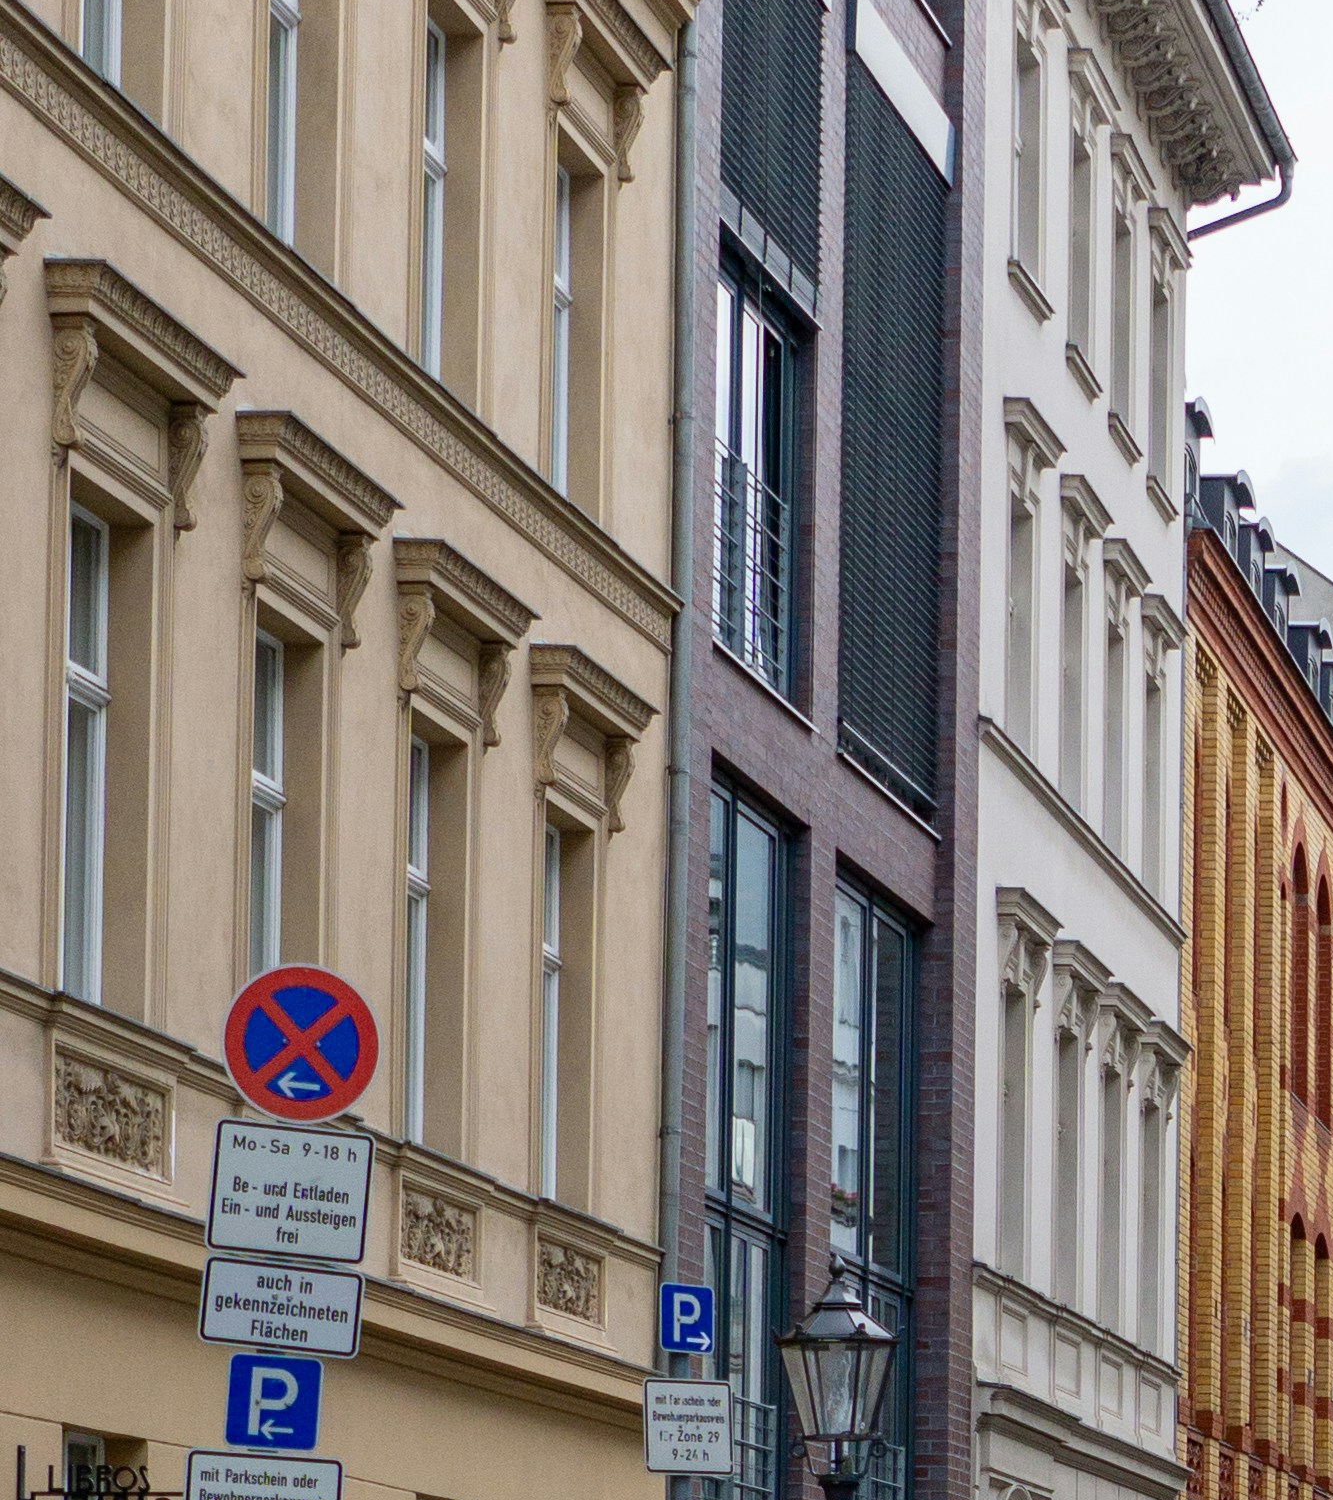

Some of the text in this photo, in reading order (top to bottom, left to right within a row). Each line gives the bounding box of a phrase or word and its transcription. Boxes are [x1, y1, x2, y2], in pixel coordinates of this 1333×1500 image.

[347, 1147, 357, 1163] h
[263, 1181, 287, 1197] und
[293, 1182, 350, 1205] Entladen
[256, 1203, 280, 1220] und
[285, 1205, 357, 1230] Aussteigen
[276, 1226, 300, 1245] frei
[256, 1274, 314, 1294] auch in
[214, 1292, 349, 1324] gekennzeichneten
[673, 1292, 701, 1343] P
[250, 1319, 309, 1343] Flächen
[247, 1366, 299, 1436] P
[677, 1429, 703, 1443] Zone
[707, 1431, 720, 1444] 29
[702, 1449, 710, 1462] h
[200, 1468, 320, 1489] mit Parkschein oder
